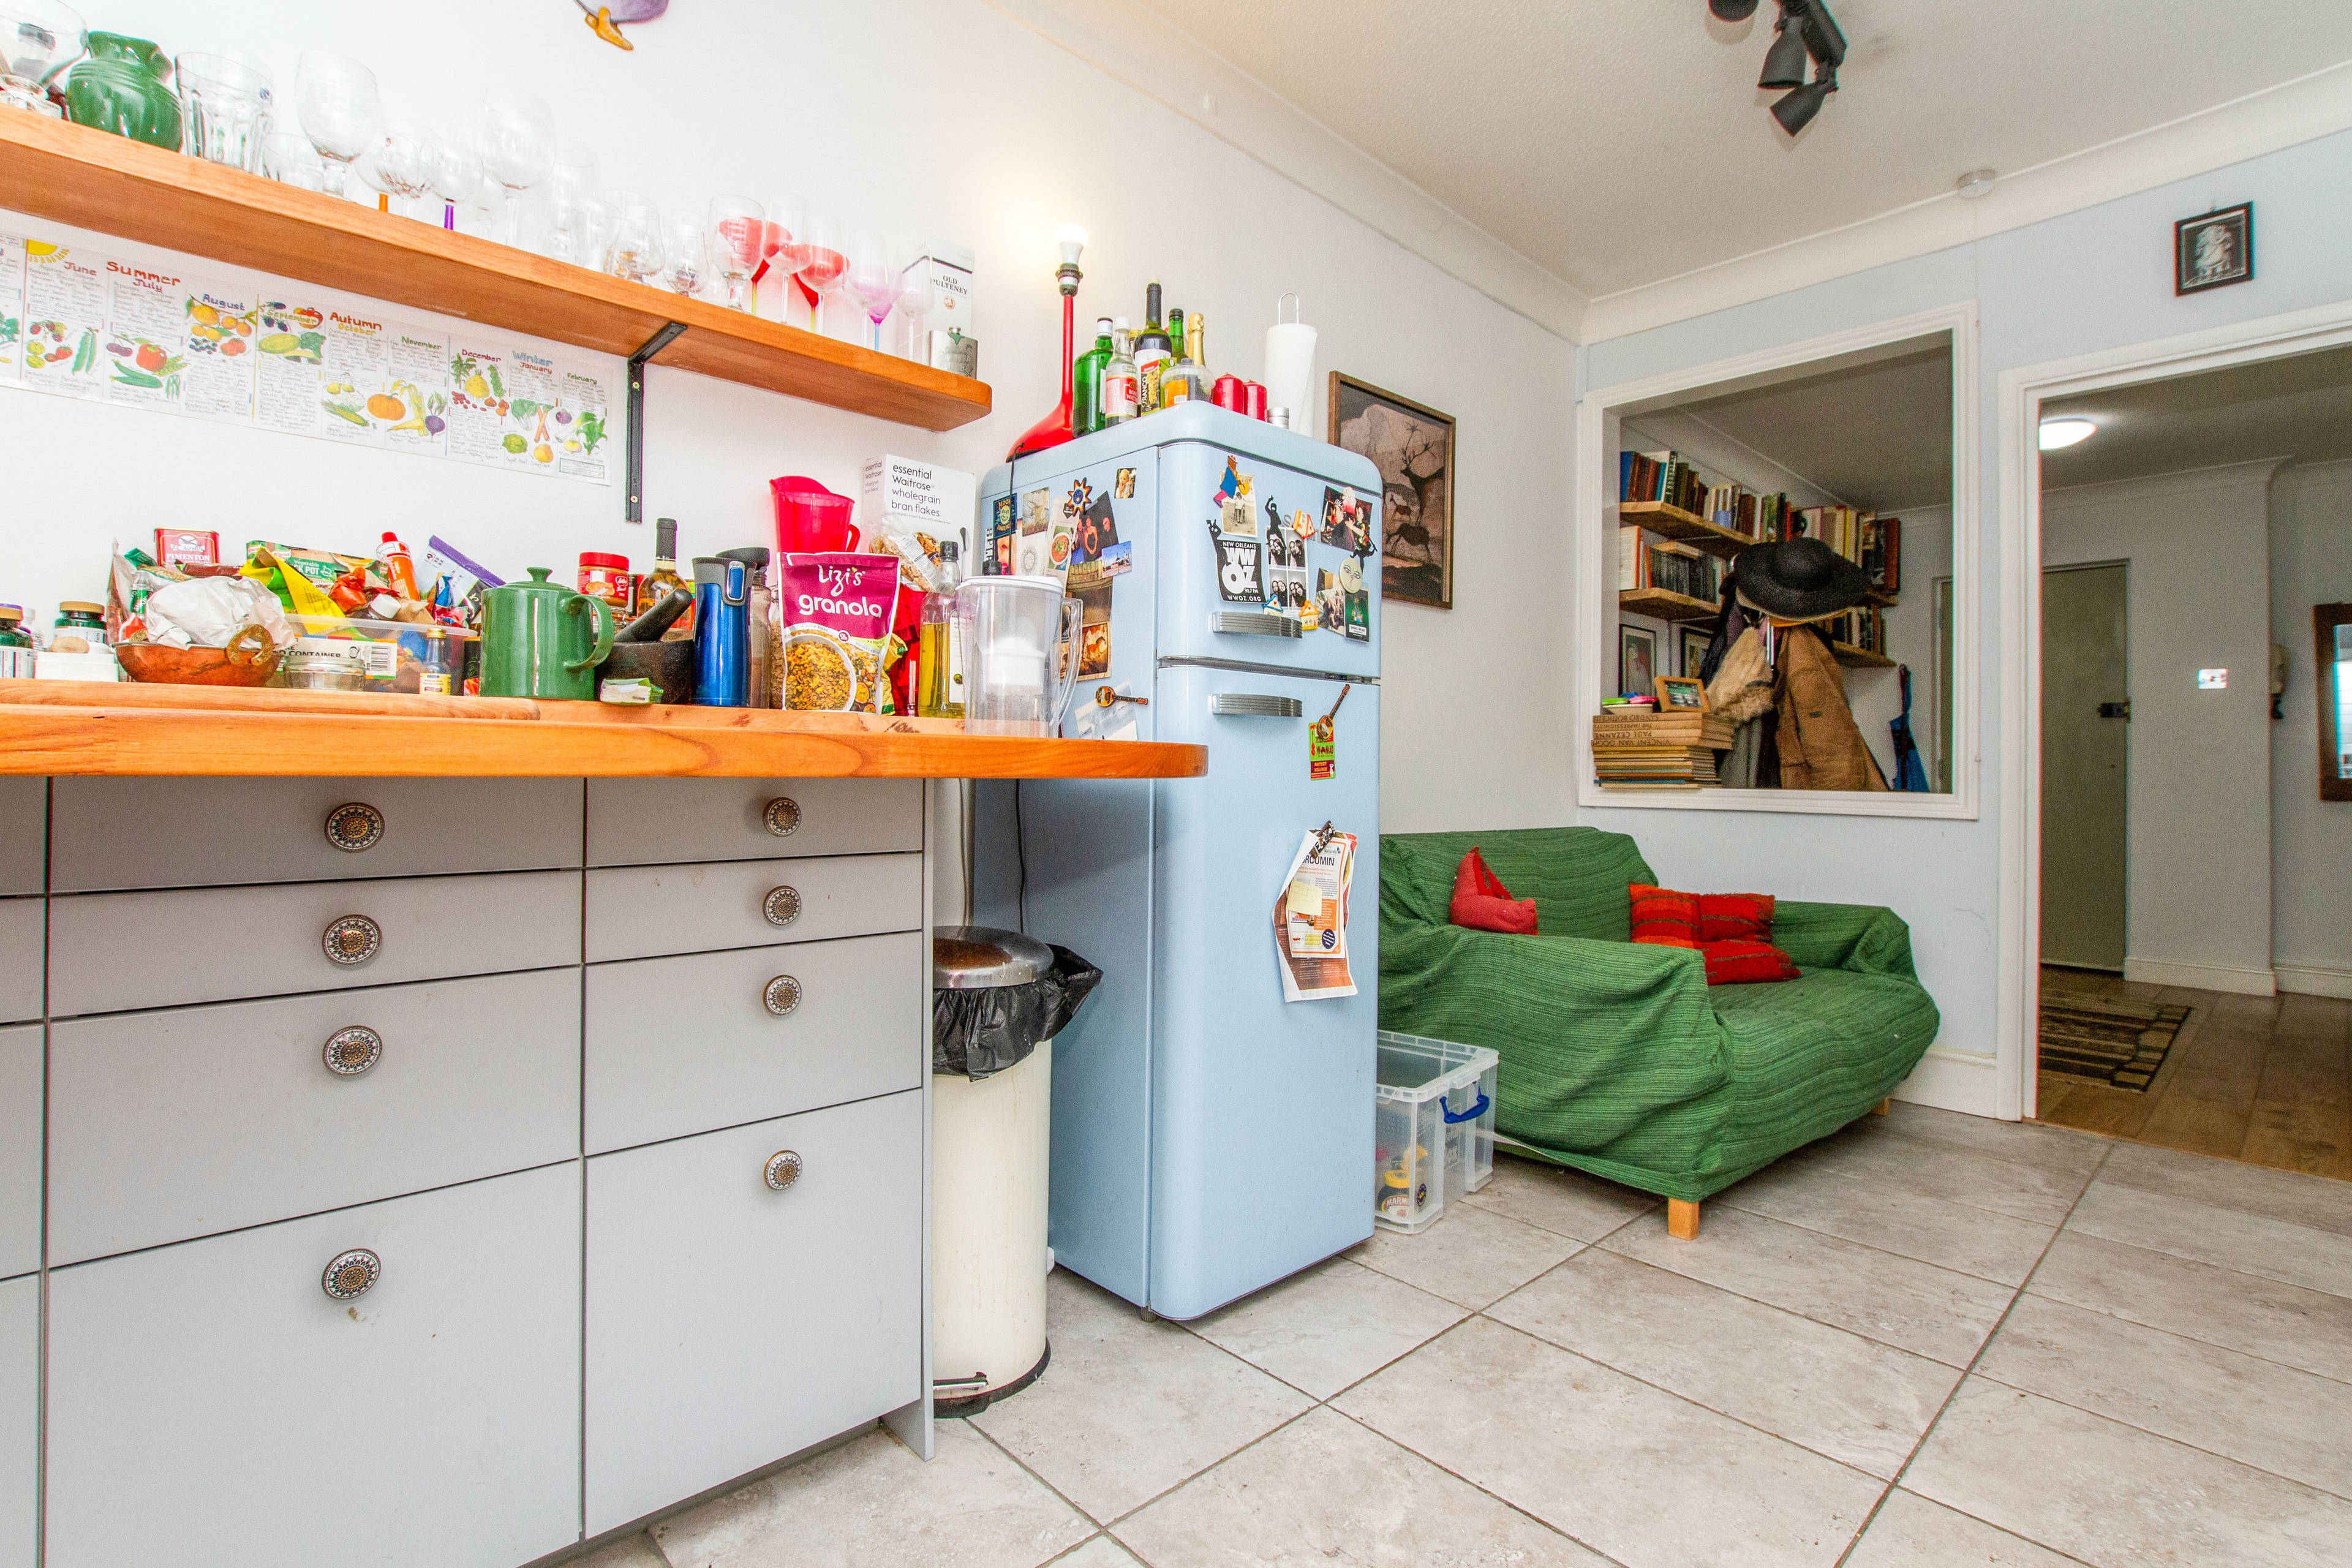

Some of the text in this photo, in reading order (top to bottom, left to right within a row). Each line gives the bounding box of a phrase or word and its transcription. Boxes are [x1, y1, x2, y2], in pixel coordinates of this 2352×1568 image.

[64, 261, 97, 276] June
[107, 261, 180, 286] Summer
[133, 279, 162, 293] July
[943, 276, 957, 284] OLD
[202, 293, 245, 311] August
[267, 309, 318, 324] September
[330, 312, 382, 331] Autumn
[337, 323, 376, 336] October
[401, 336, 442, 350] November
[462, 349, 501, 362] December
[512, 350, 553, 366] Winter
[520, 362, 552, 374] January
[567, 372, 597, 385] February
[892, 464, 932, 480] essential
[892, 475, 932, 491] Waitrose
[892, 488, 941, 505] wholegrain
[891, 500, 940, 517] bran flakes
[166, 552, 210, 561] PIMENTON
[304, 566, 320, 575] POT
[818, 564, 865, 597] Lizi's
[798, 594, 882, 618] granola
[1303, 855, 1335, 866] RCUMIN
